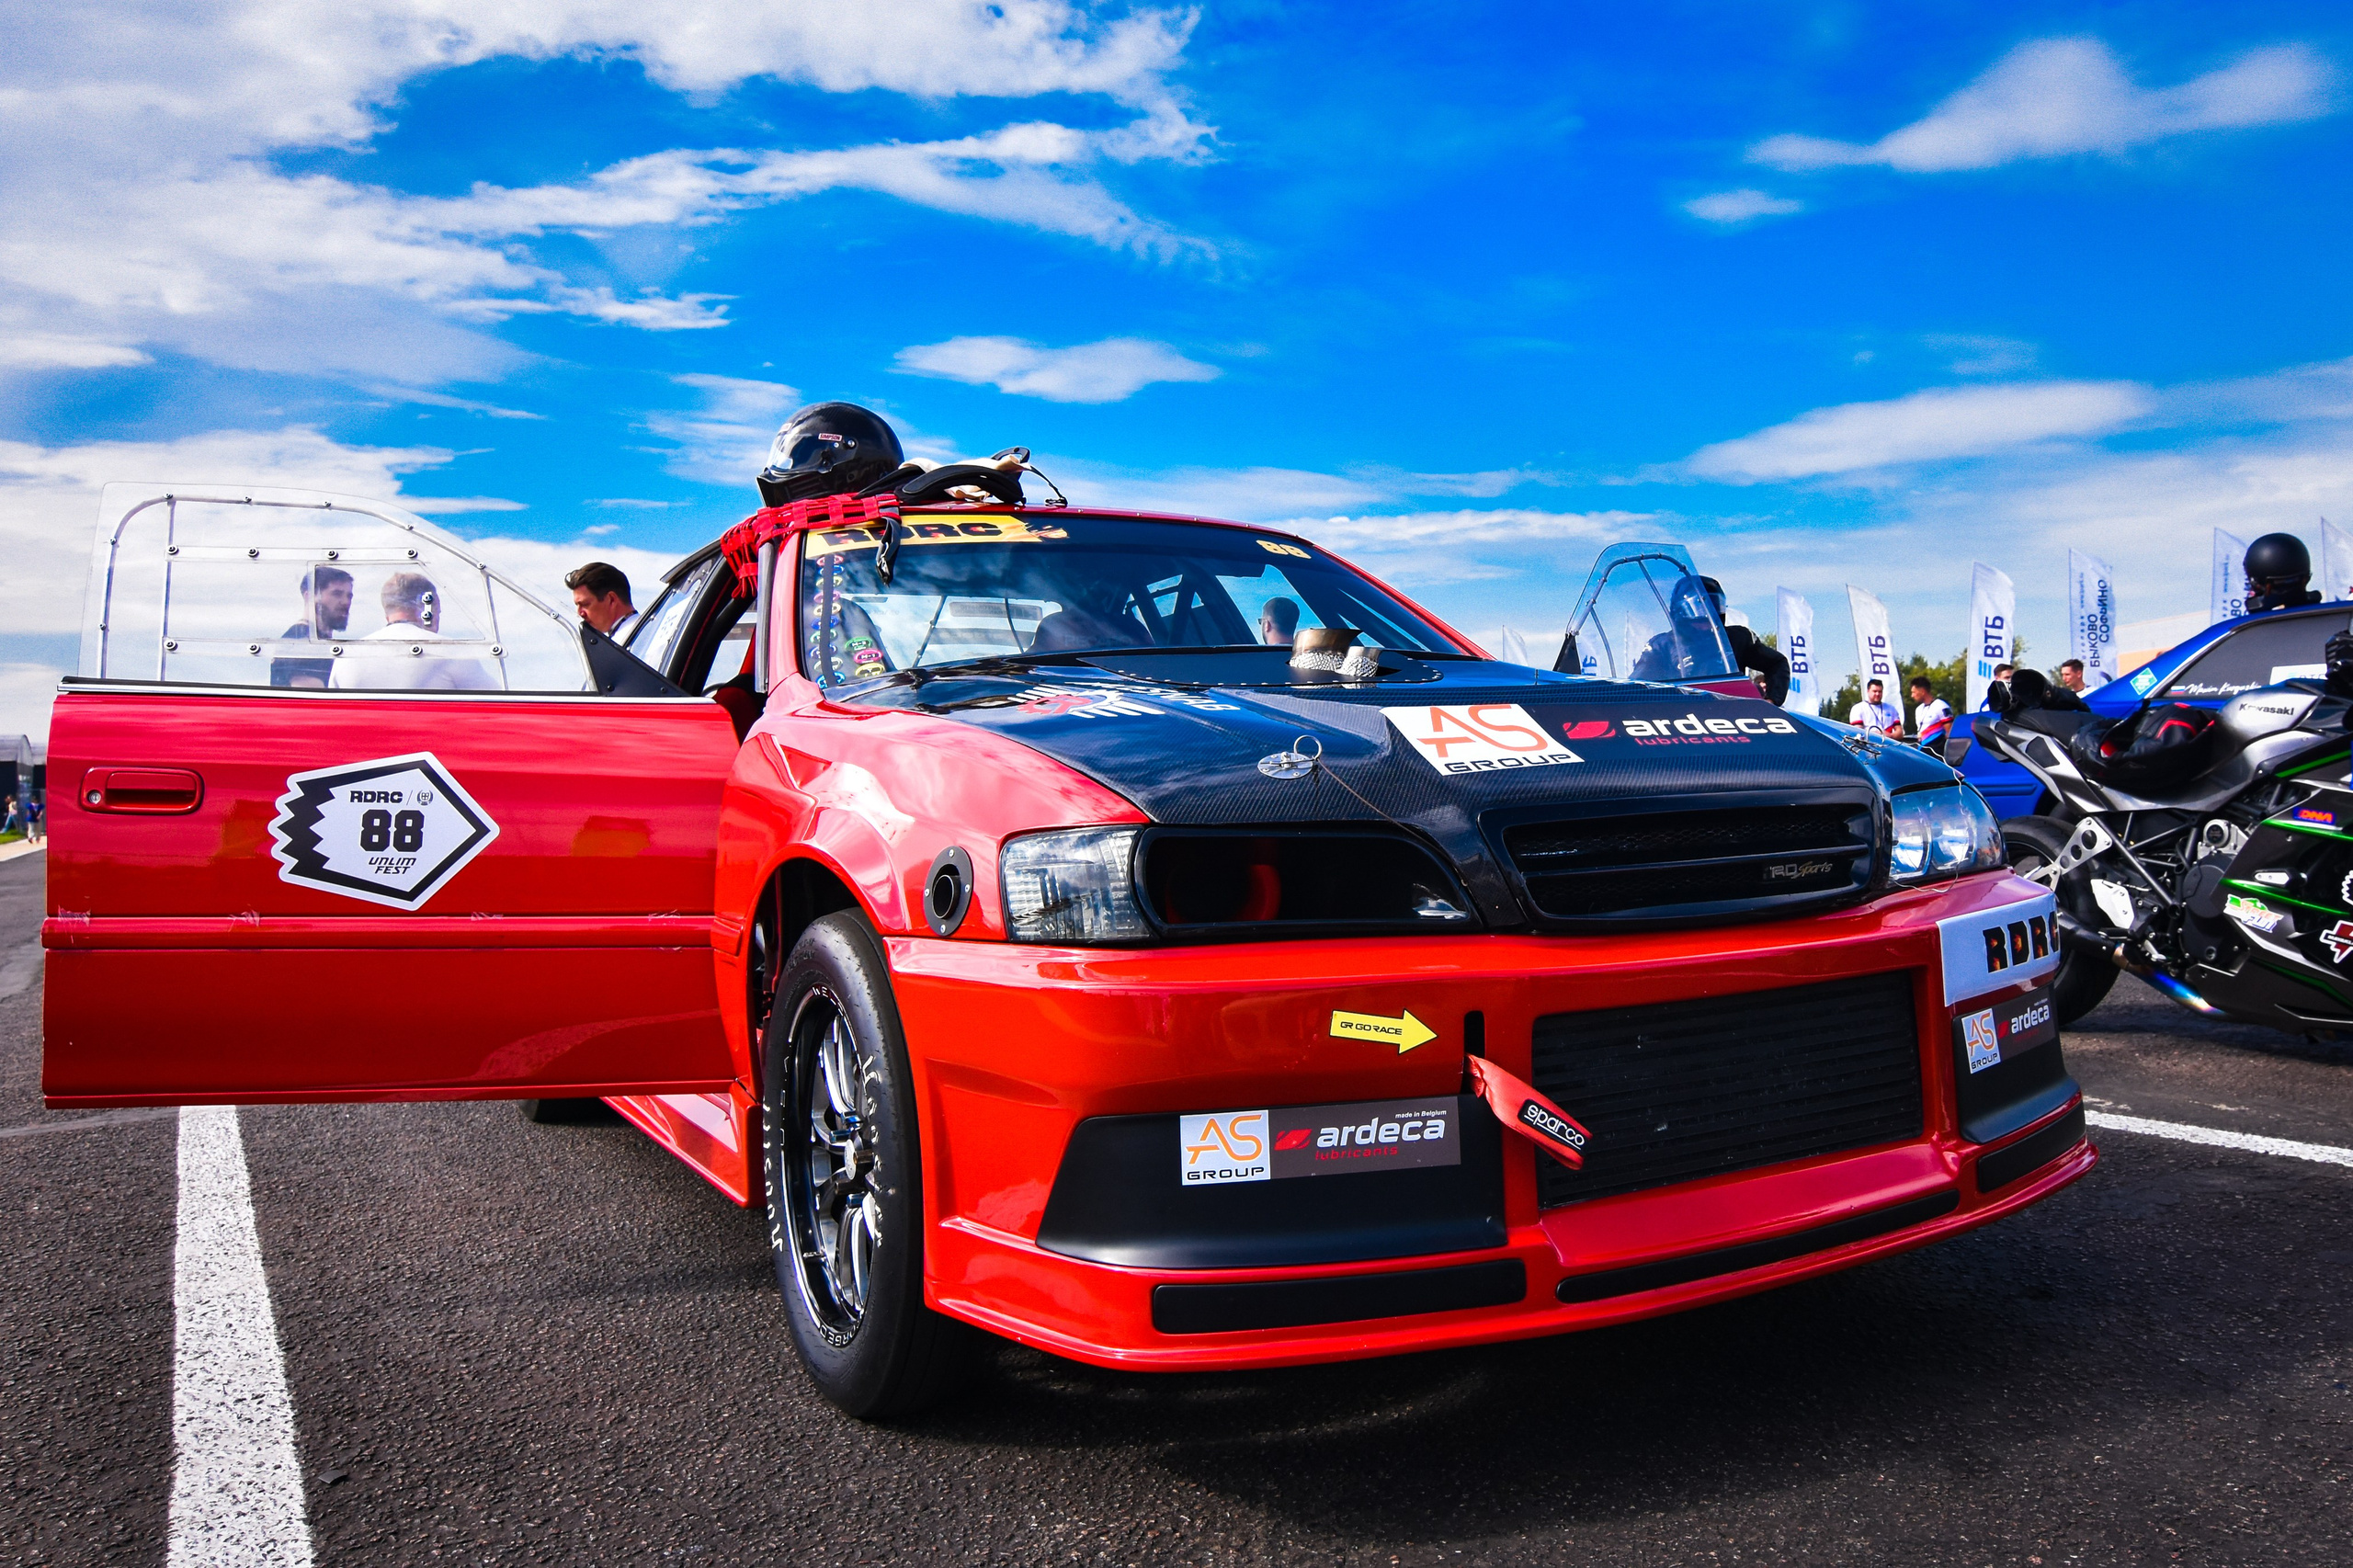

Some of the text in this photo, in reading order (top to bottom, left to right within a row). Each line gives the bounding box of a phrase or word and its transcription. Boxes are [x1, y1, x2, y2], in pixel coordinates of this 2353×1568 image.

[1256, 540, 1312, 559] 88
[1984, 615, 2005, 659] ВТБ
[2087, 614, 2100, 667] БЫКОВО
[1790, 635, 1809, 674] ВТБ
[1868, 635, 1890, 676] ВТБ
[1416, 703, 1549, 758] AS
[1622, 714, 1798, 736] ardeca
[1634, 736, 1752, 745] lubricants
[1443, 753, 1573, 773] GROUP
[350, 790, 404, 803] RDRC
[360, 809, 425, 853] 88
[369, 857, 416, 866] UNLIM
[374, 866, 410, 874] FEST
[1355, 1023, 1371, 1031] GO
[1372, 1025, 1403, 1036] RACE
[2011, 1004, 2050, 1034] ardeca
[1968, 1012, 1995, 1057] AS
[1971, 1052, 1998, 1070] GROUP
[1421, 1109, 1447, 1118] Belgium
[1316, 1118, 1446, 1148] ardeca
[1527, 1105, 1585, 1146] sparco
[1186, 1114, 1262, 1165] AS
[1315, 1146, 1398, 1161] lubricants
[1187, 1166, 1265, 1180] GROUP
